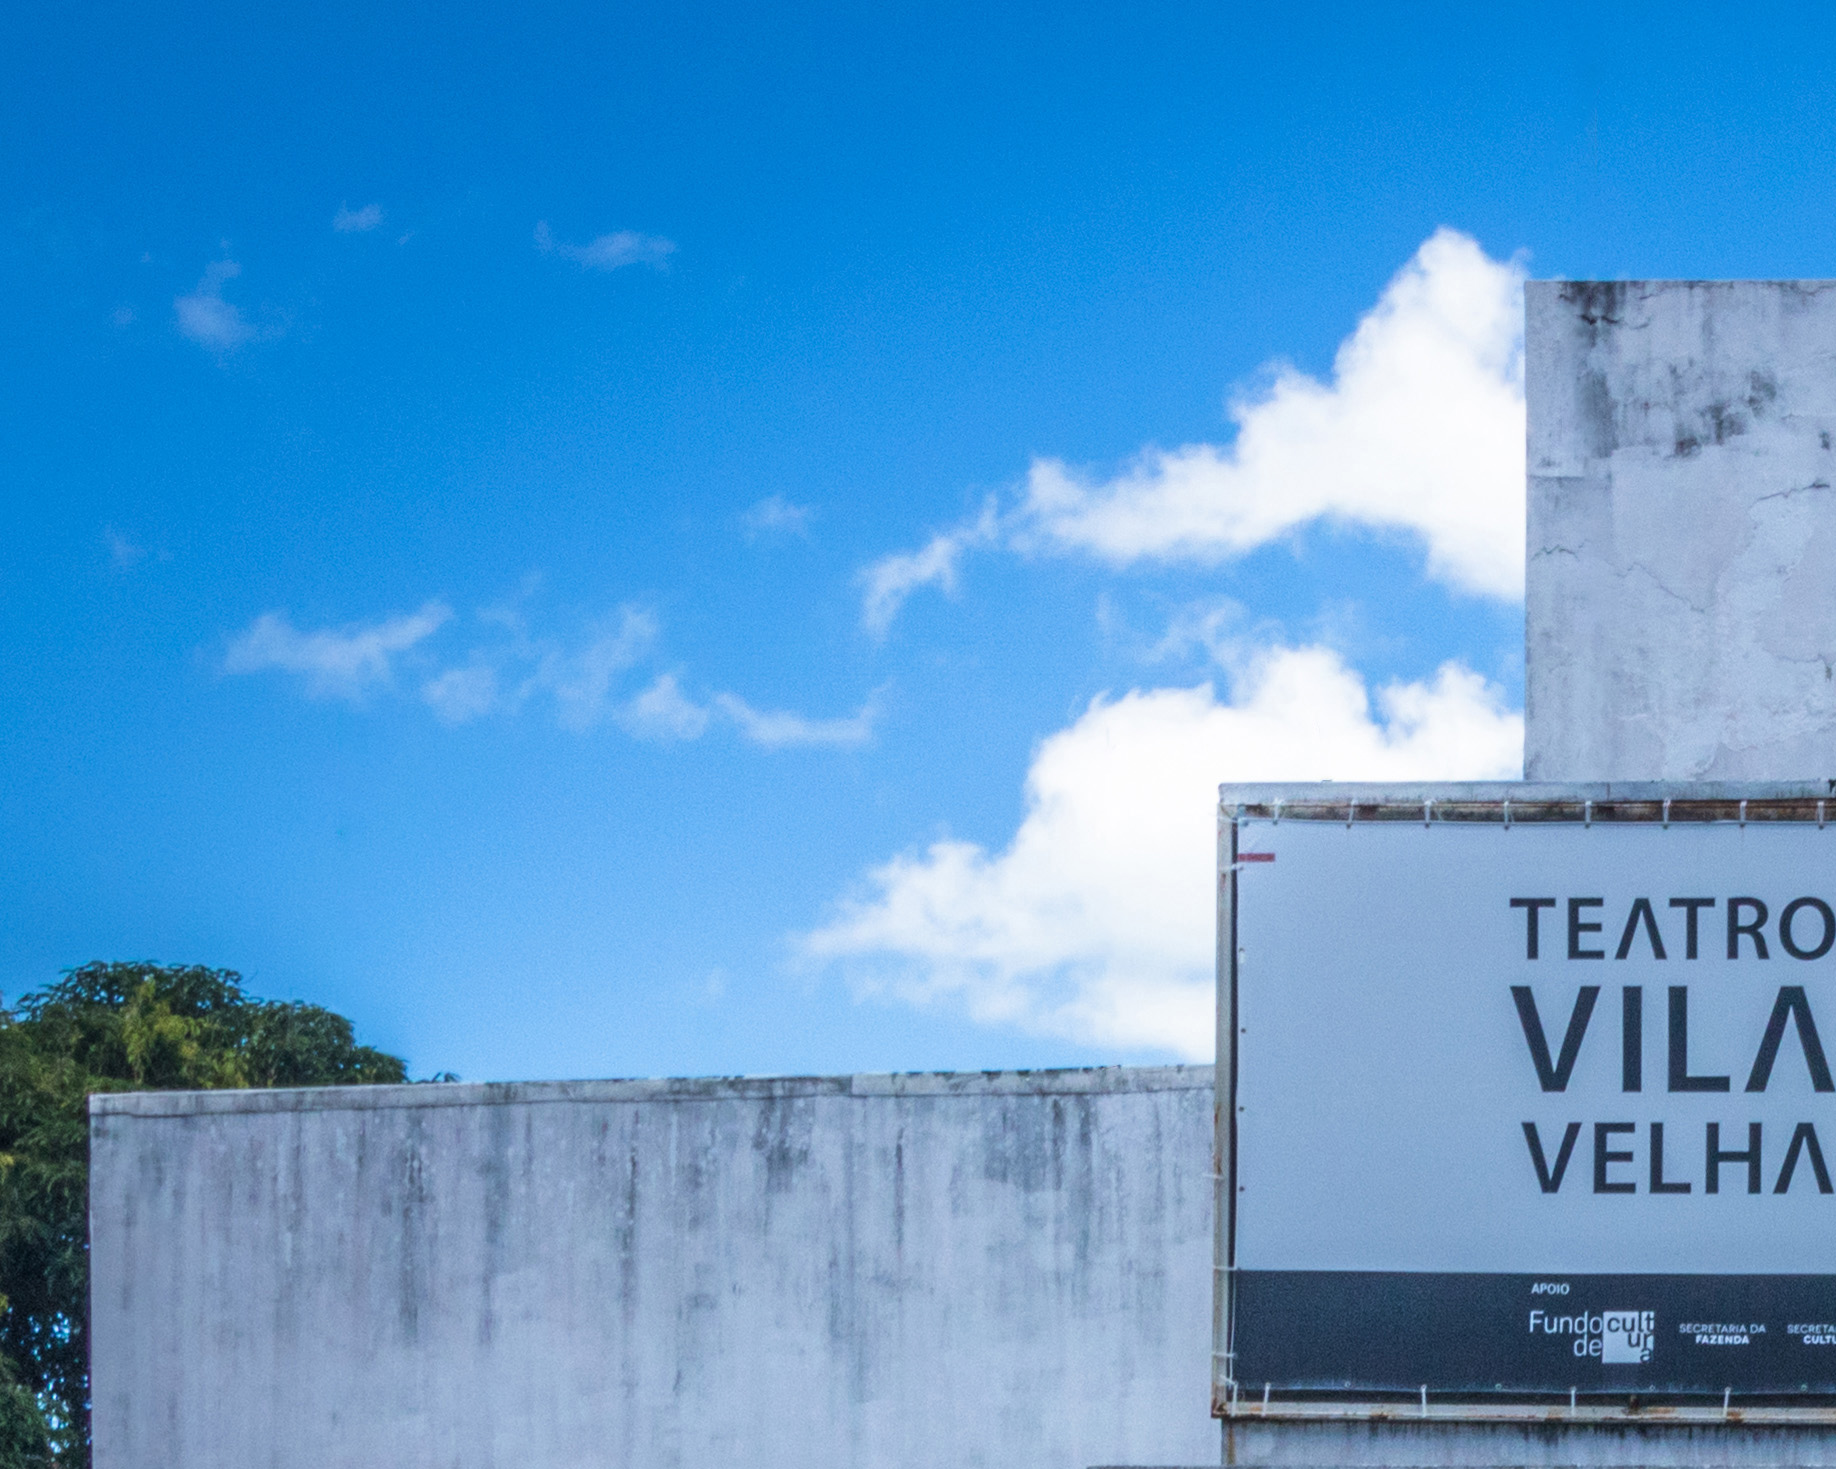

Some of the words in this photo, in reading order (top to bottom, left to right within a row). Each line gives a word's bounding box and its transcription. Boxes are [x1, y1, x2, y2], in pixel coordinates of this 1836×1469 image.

[1509, 985, 1836, 1093] VILA
[1520, 1122, 1835, 1195] VELHA
[1531, 1282, 1570, 1295] APOIO
[1529, 1310, 1603, 1334] Fundo
[1679, 1323, 1747, 1334] SECRETARIA
[1750, 1324, 1767, 1334] DA
[1695, 1335, 1750, 1345] FAZENDA
